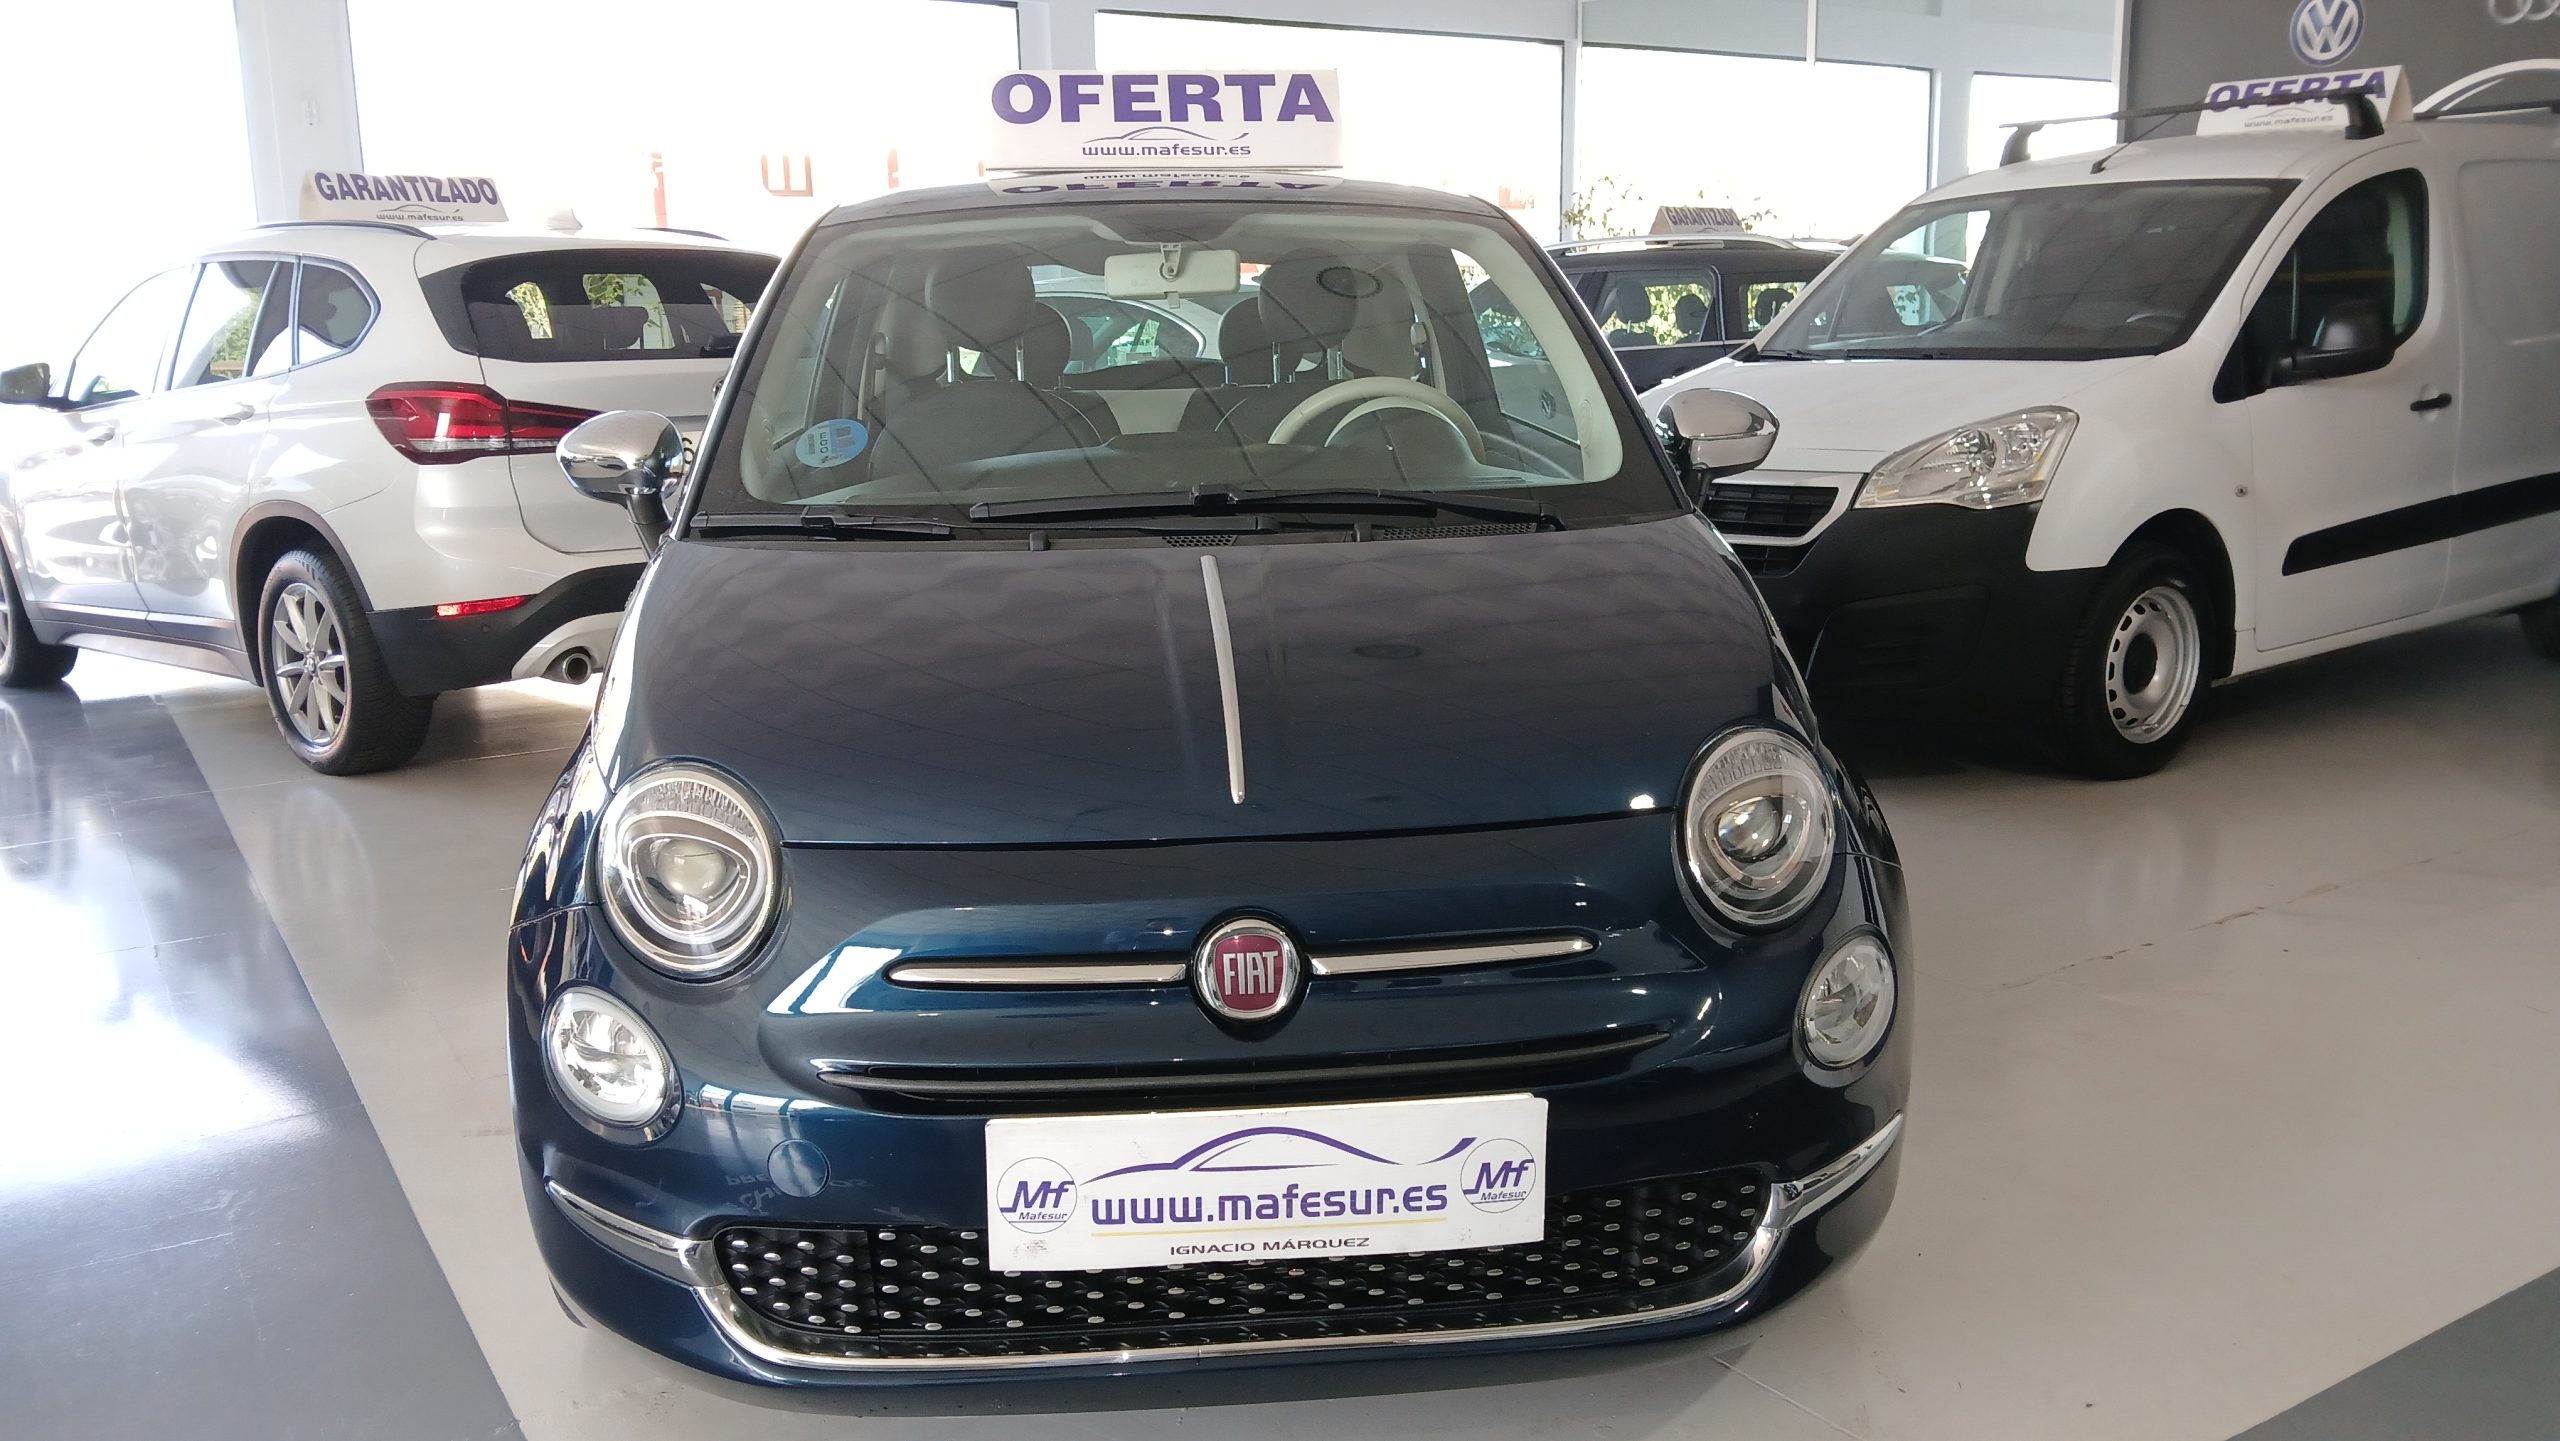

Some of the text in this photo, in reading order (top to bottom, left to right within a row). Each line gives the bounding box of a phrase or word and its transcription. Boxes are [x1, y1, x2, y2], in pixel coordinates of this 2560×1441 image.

[991, 74, 1335, 124] OFERTA
[1082, 143, 1251, 156] www.mafesur.es
[315, 172, 498, 205] GARANTIZADO
[376, 213, 464, 221] www.mafesur.es
[1223, 951, 1279, 996] FIAT
[1091, 1184, 1447, 1225] www.mafesur.es
[1480, 1190, 1527, 1201] Mafesur
[1018, 1211, 1068, 1221] Mafesur
[1170, 1237, 1370, 1256] IGNACIO MÁRQUEZ
